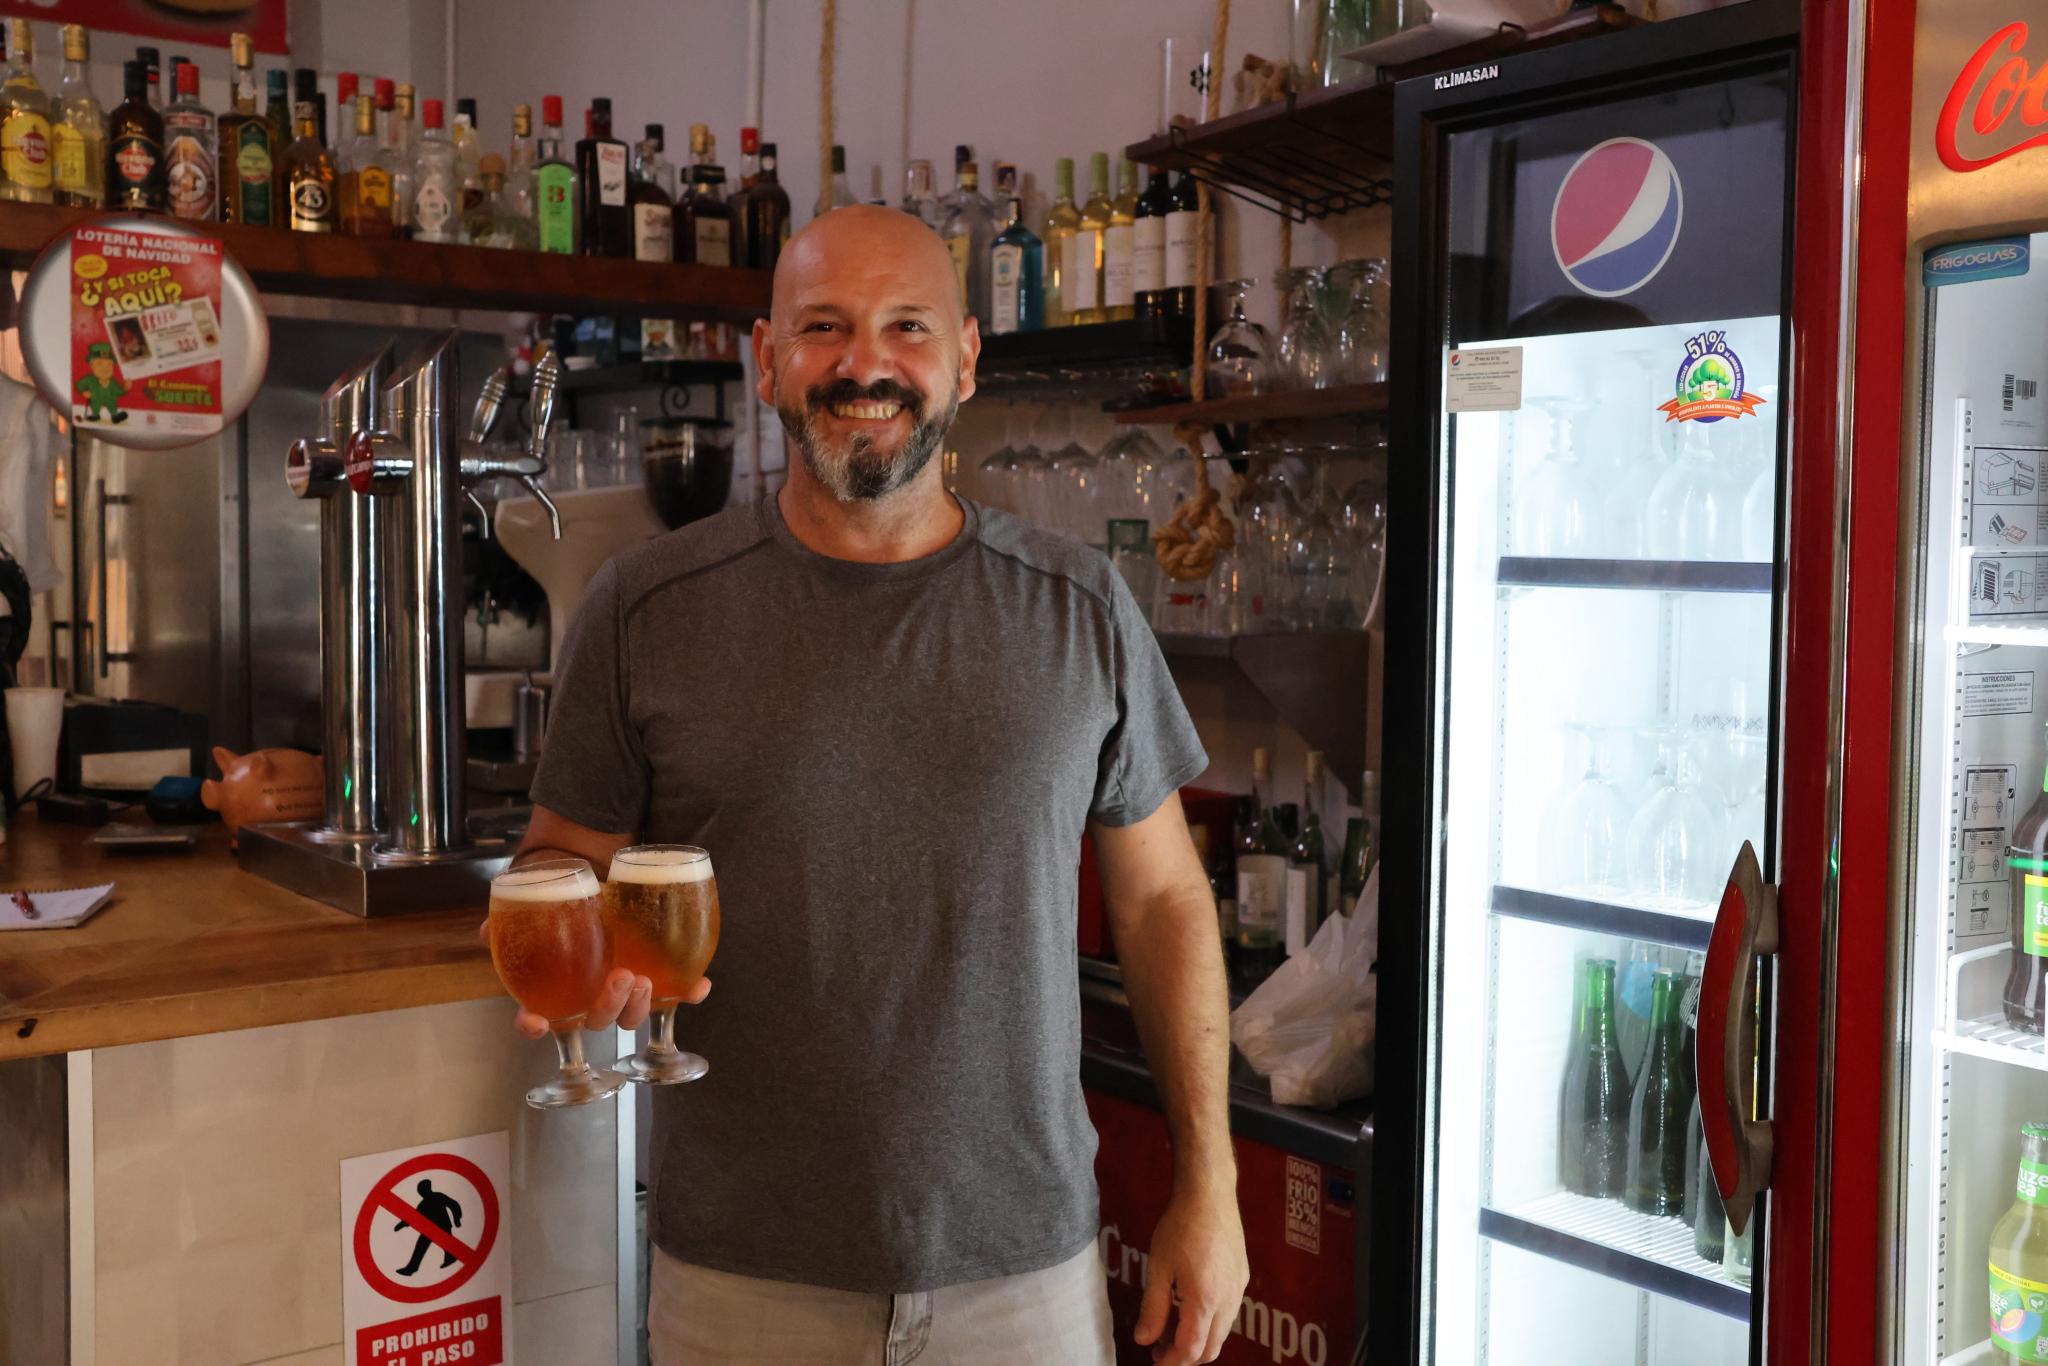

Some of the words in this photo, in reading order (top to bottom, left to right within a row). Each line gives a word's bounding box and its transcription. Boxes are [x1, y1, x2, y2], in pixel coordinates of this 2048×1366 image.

[129, 187, 140, 200] 7
[76, 229, 138, 247] LOTERÍA
[142, 238, 218, 255] NACIONAL
[102, 245, 122, 257] DE
[126, 247, 192, 264] NAVIDAD
[1932, 248, 2017, 270] FRIGOGLASS
[107, 275, 126, 291] SI
[127, 265, 172, 286] TOCA
[104, 281, 183, 317] AQUÍ?
[1686, 330, 1726, 360] 51%
[1703, 381, 1717, 400] 5
[1288, 1160, 1319, 1181] 100%
[1288, 1197, 1317, 1225] 35%
[371, 1313, 489, 1357] PROHIBIDO
[422, 1340, 475, 1366] PASO
